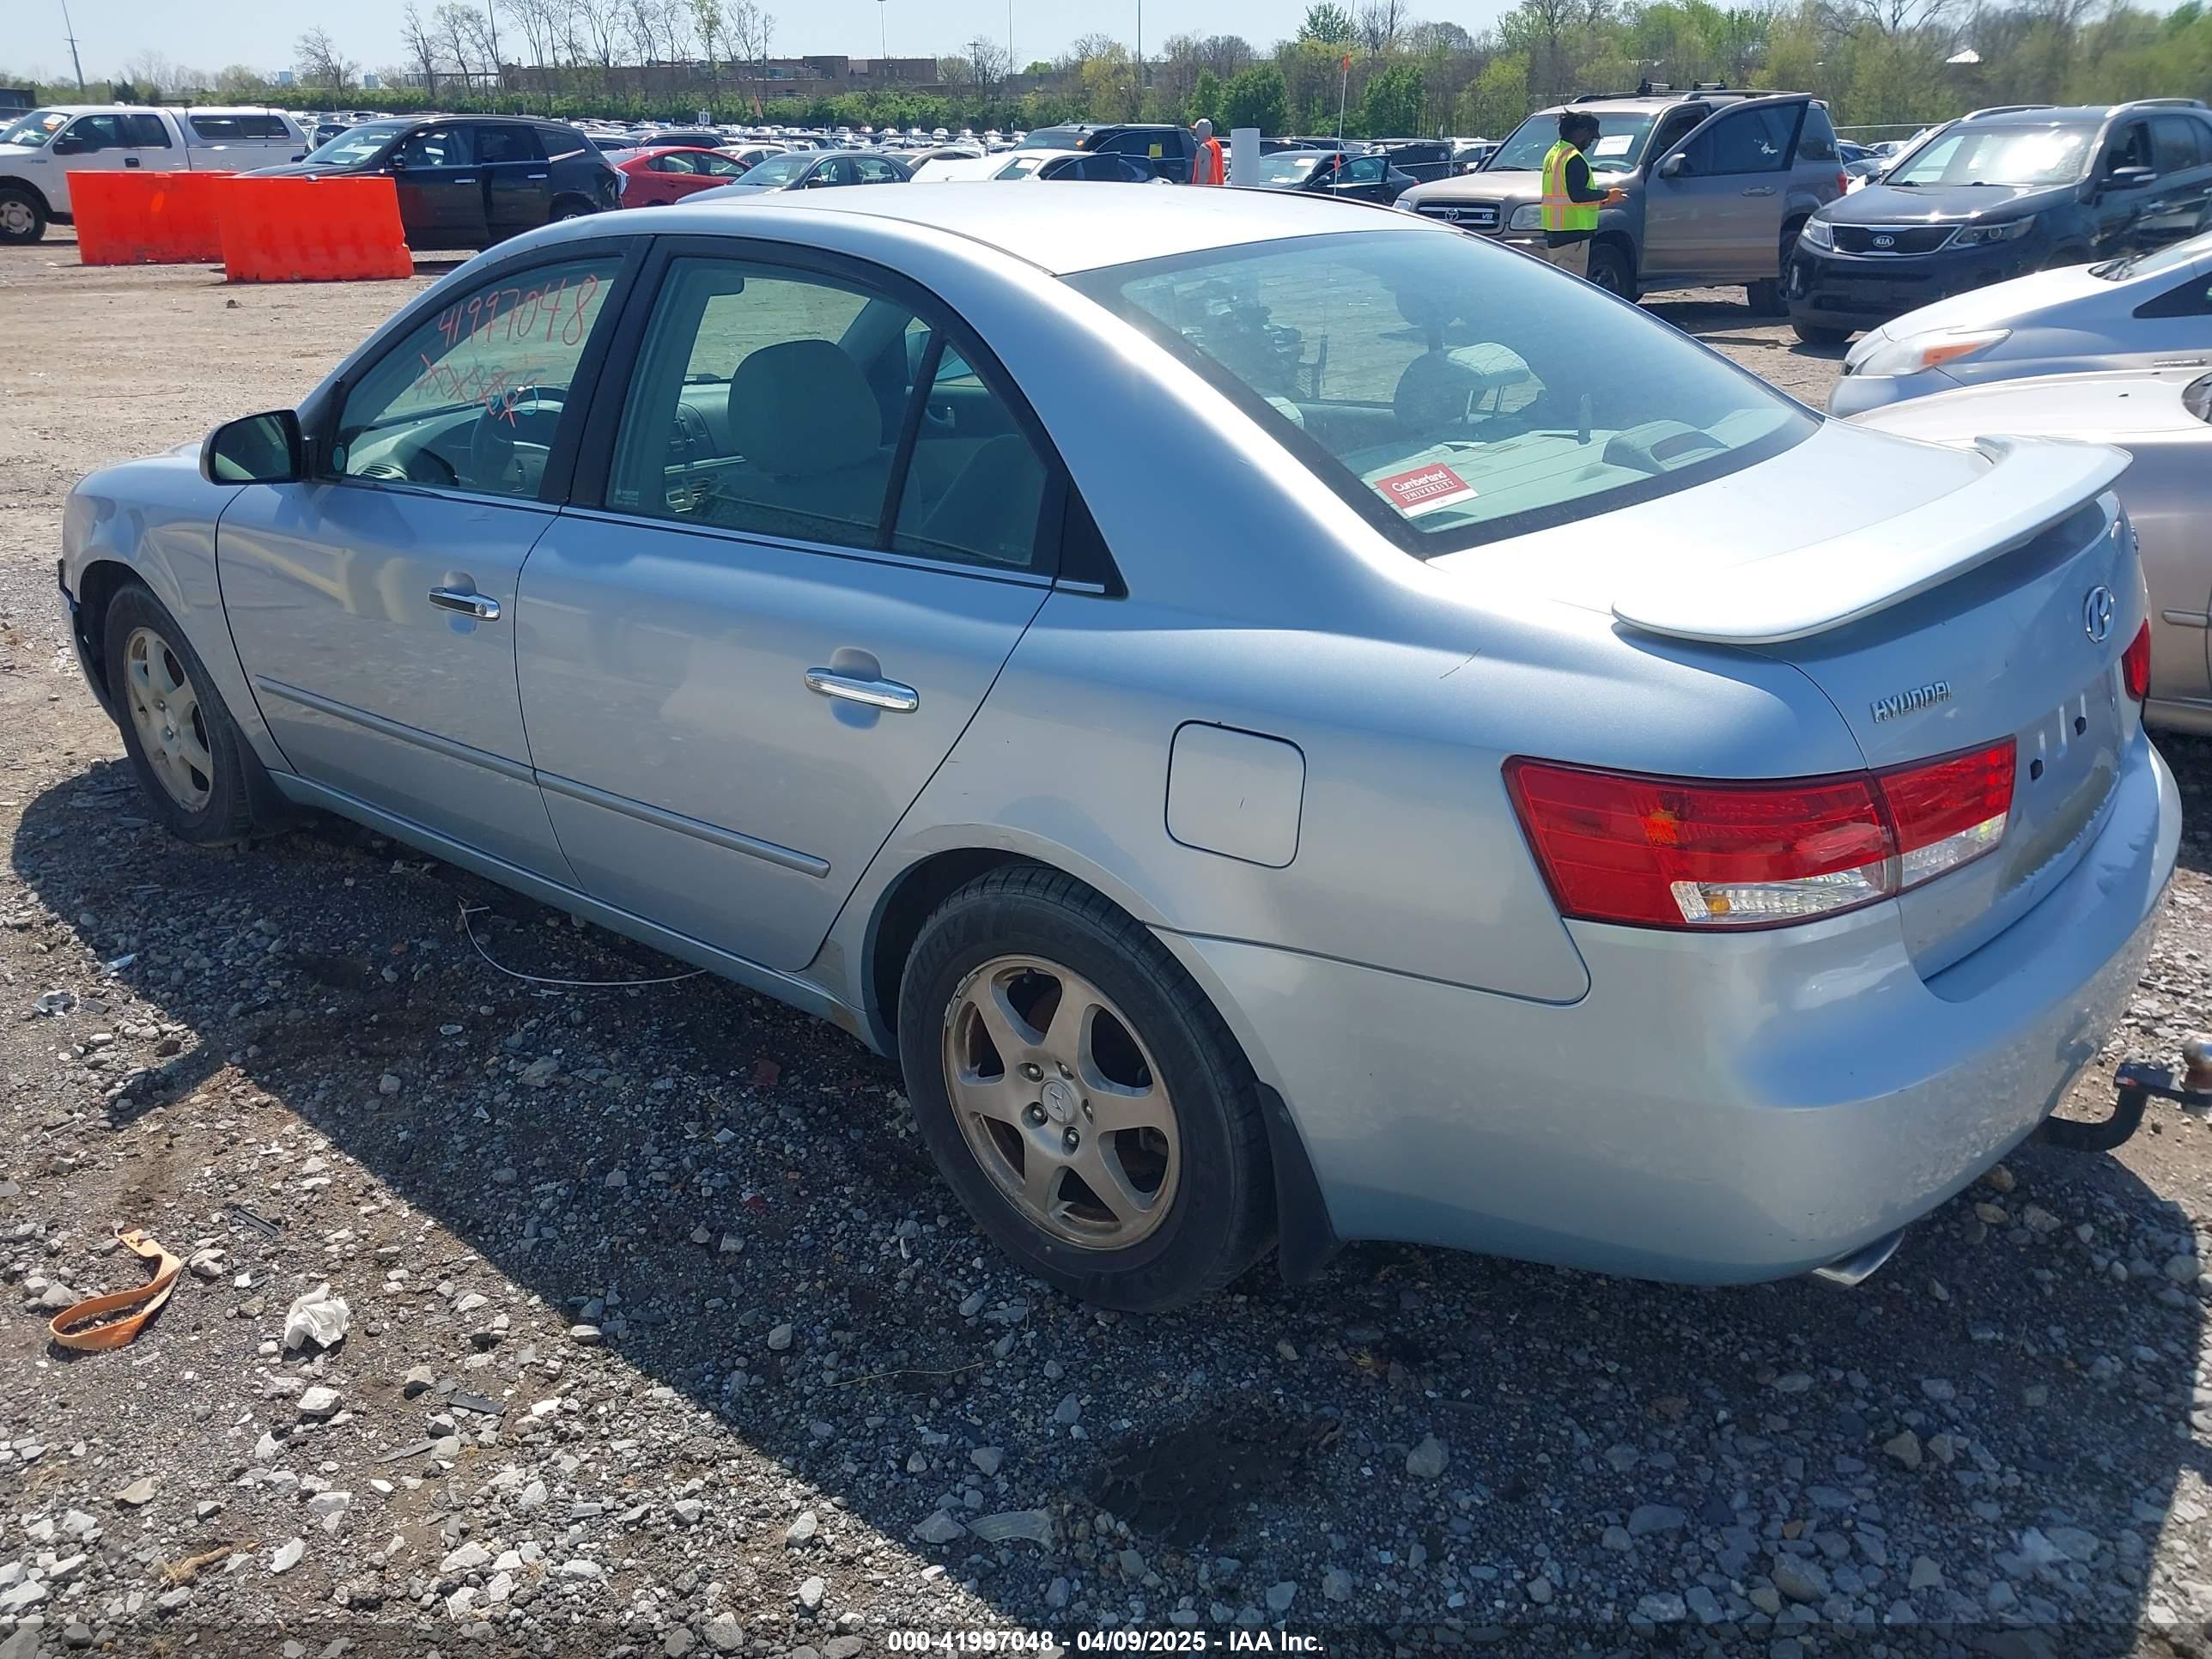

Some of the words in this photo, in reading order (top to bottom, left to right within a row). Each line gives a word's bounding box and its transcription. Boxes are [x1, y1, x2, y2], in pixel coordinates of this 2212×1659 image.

[1875, 237, 1891, 246] KIA
[438, 274, 598, 348] 41997048
[1391, 470, 1448, 492] Cumberland
[1401, 480, 1455, 501] UNIVERSITY
[1869, 681, 1951, 723] HYUNDAI
